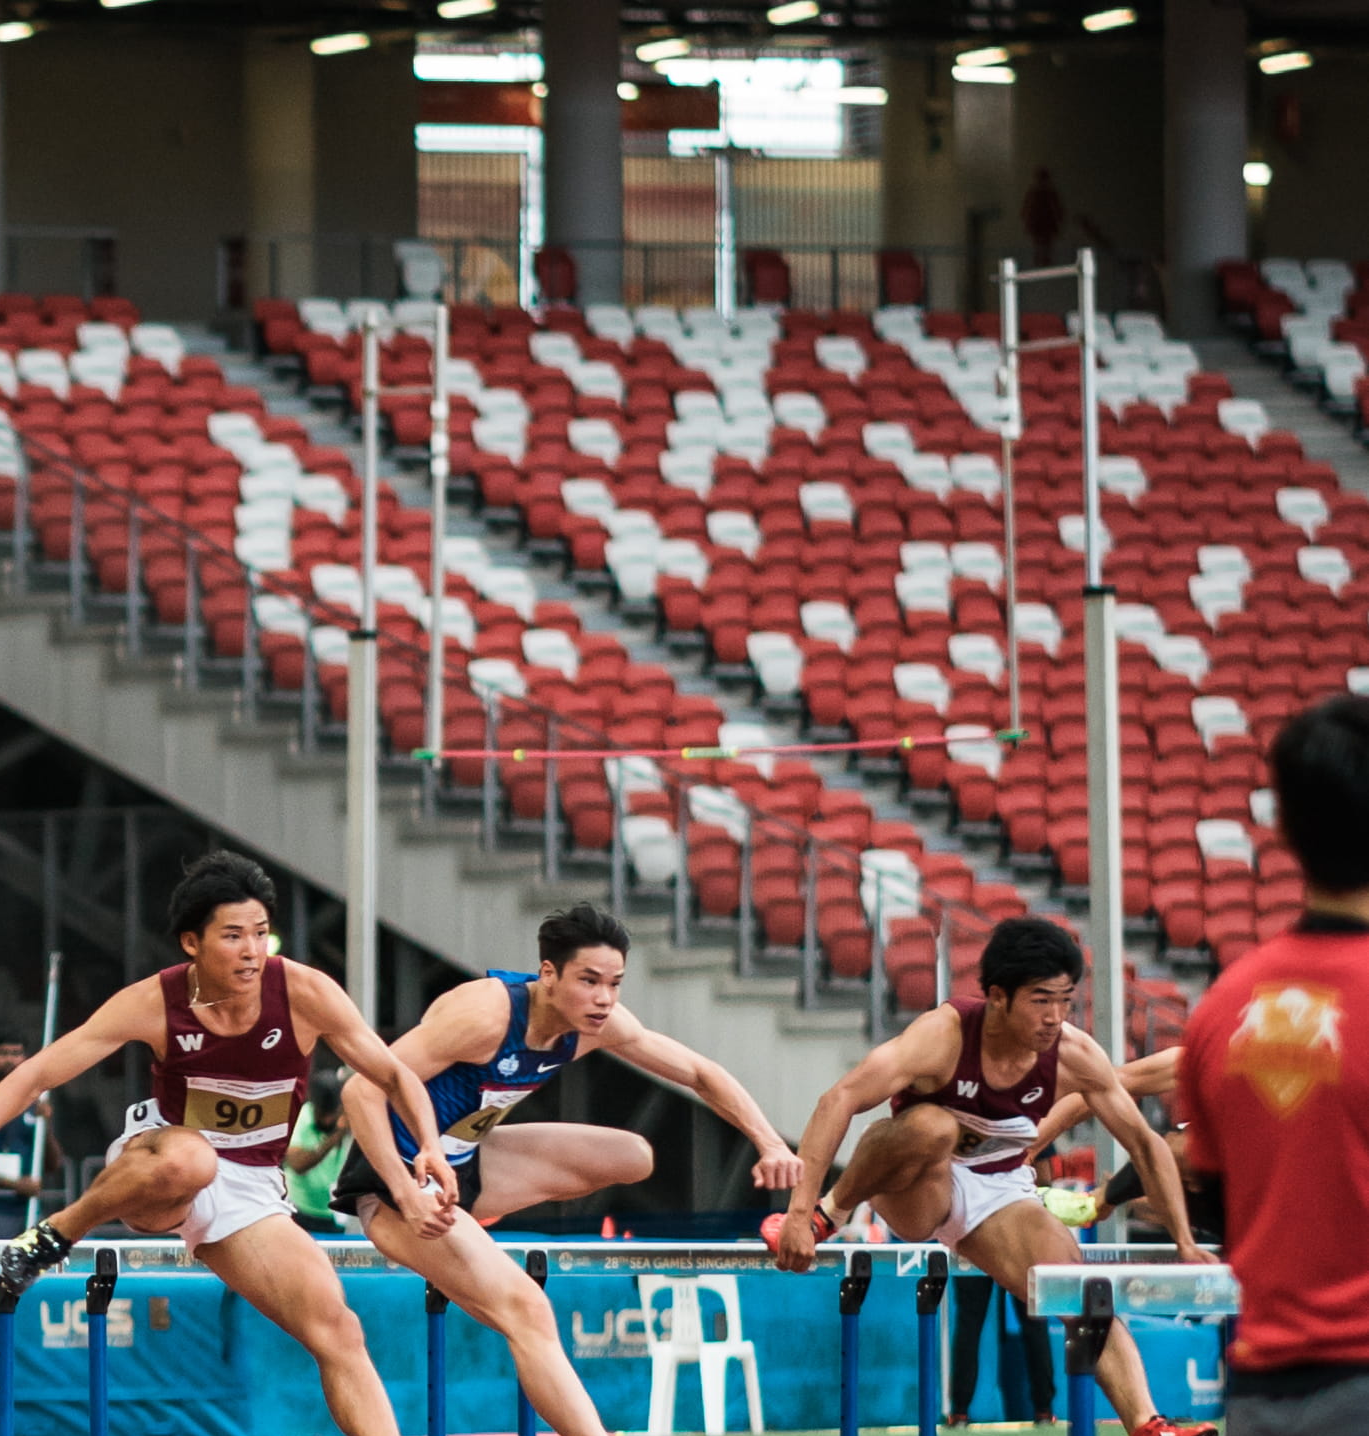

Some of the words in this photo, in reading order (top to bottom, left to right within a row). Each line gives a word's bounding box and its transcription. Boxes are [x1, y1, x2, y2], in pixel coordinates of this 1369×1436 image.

[176, 1034, 204, 1052] W
[957, 1080, 979, 1098] W
[215, 1099, 264, 1130] 90
[630, 1256, 651, 1269] SEA
[653, 1256, 694, 1269] GAMES
[696, 1257, 762, 1270] SINGAPORE
